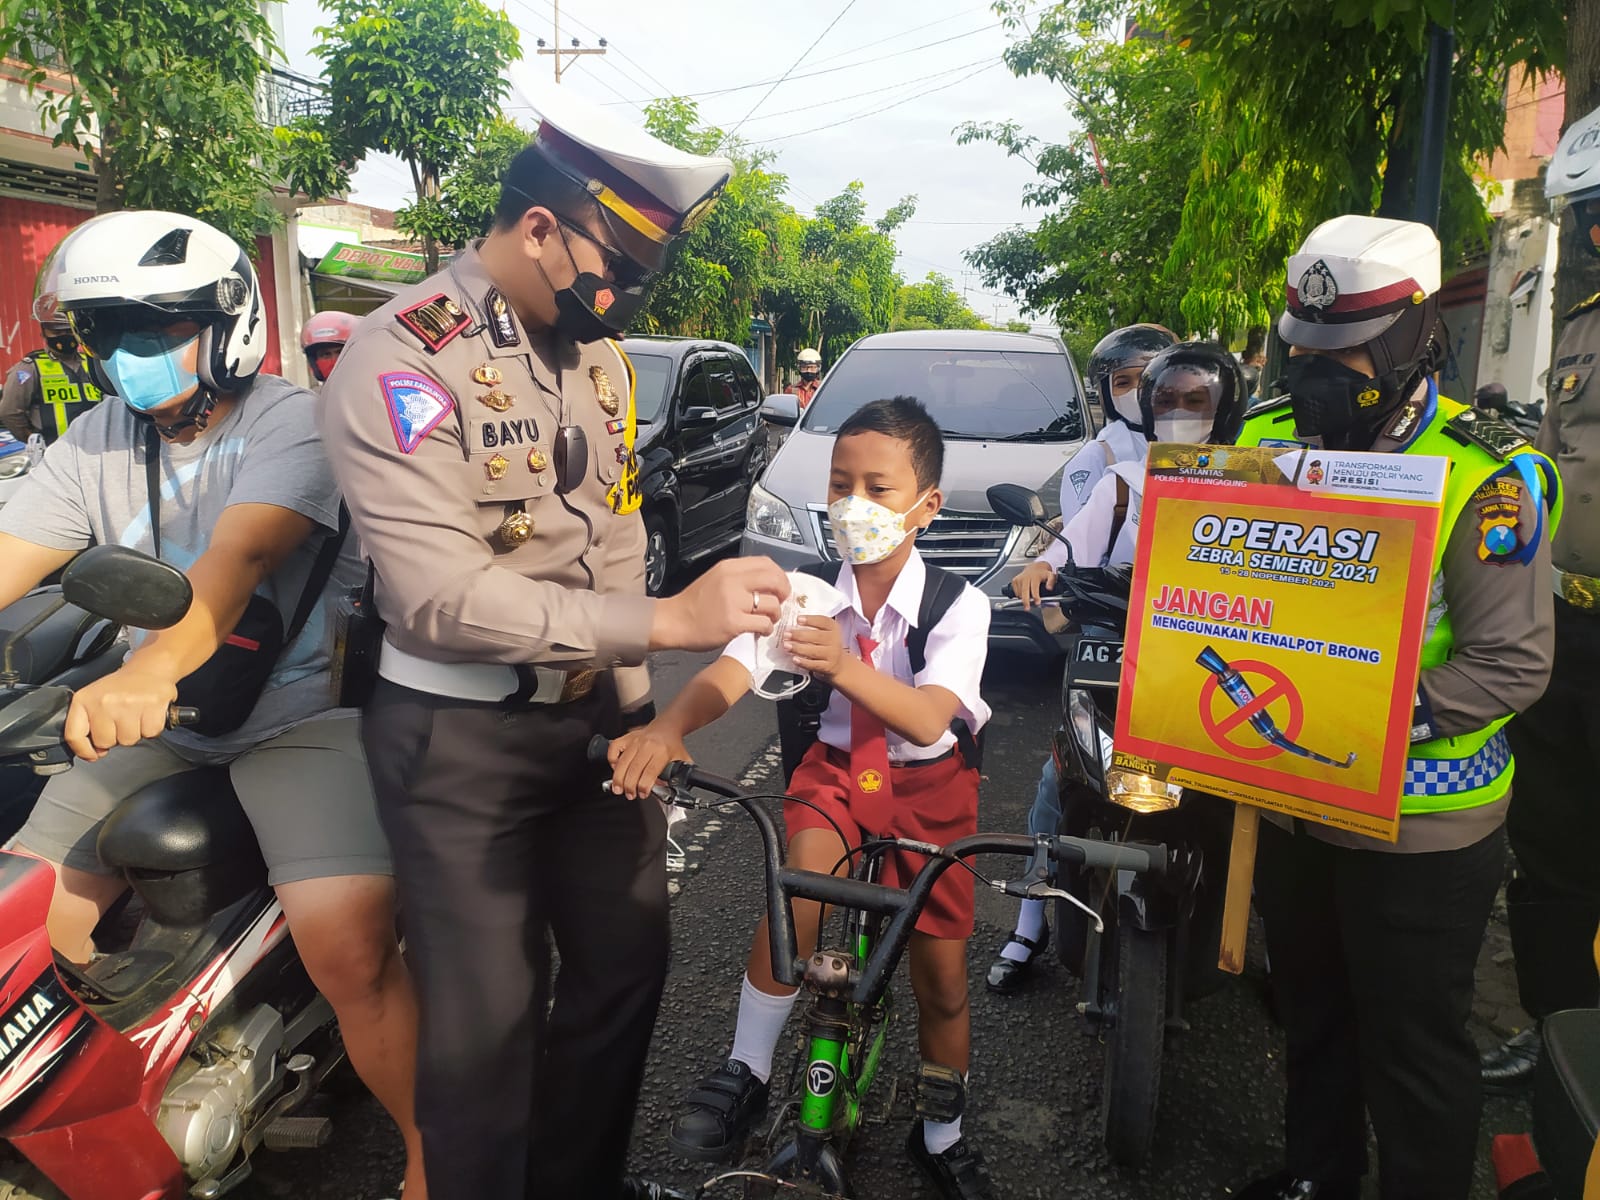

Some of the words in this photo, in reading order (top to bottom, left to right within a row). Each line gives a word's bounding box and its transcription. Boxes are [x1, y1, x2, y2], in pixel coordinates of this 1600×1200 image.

[334, 247, 391, 266] DEPOT
[74, 275, 120, 285] HONDA
[482, 418, 540, 448] BAYU
[1179, 467, 1224, 477] SATLANTAS
[1333, 469, 1369, 477] MENUJU
[1398, 474, 1424, 482] YANG
[1334, 461, 1401, 472] TRANSFORMASI
[1154, 474, 1185, 483] POLRES
[1332, 476, 1379, 486] PRESISI
[1192, 515, 1380, 563] OPERASI
[1187, 545, 1244, 567] ZEBRA
[1248, 552, 1328, 577] SEMERU
[1329, 562, 1378, 583] 2021
[1238, 569, 1249, 577] 28
[1251, 571, 1309, 585] NOPEMBER
[1311, 578, 1336, 588] 2021
[1152, 585, 1273, 628] JANGAN
[1152, 614, 1249, 642] MENGGUNAKAN
[1251, 631, 1325, 655] KENALPOT
[1327, 643, 1381, 664] BRONG
[1081, 645, 1110, 663] AG
